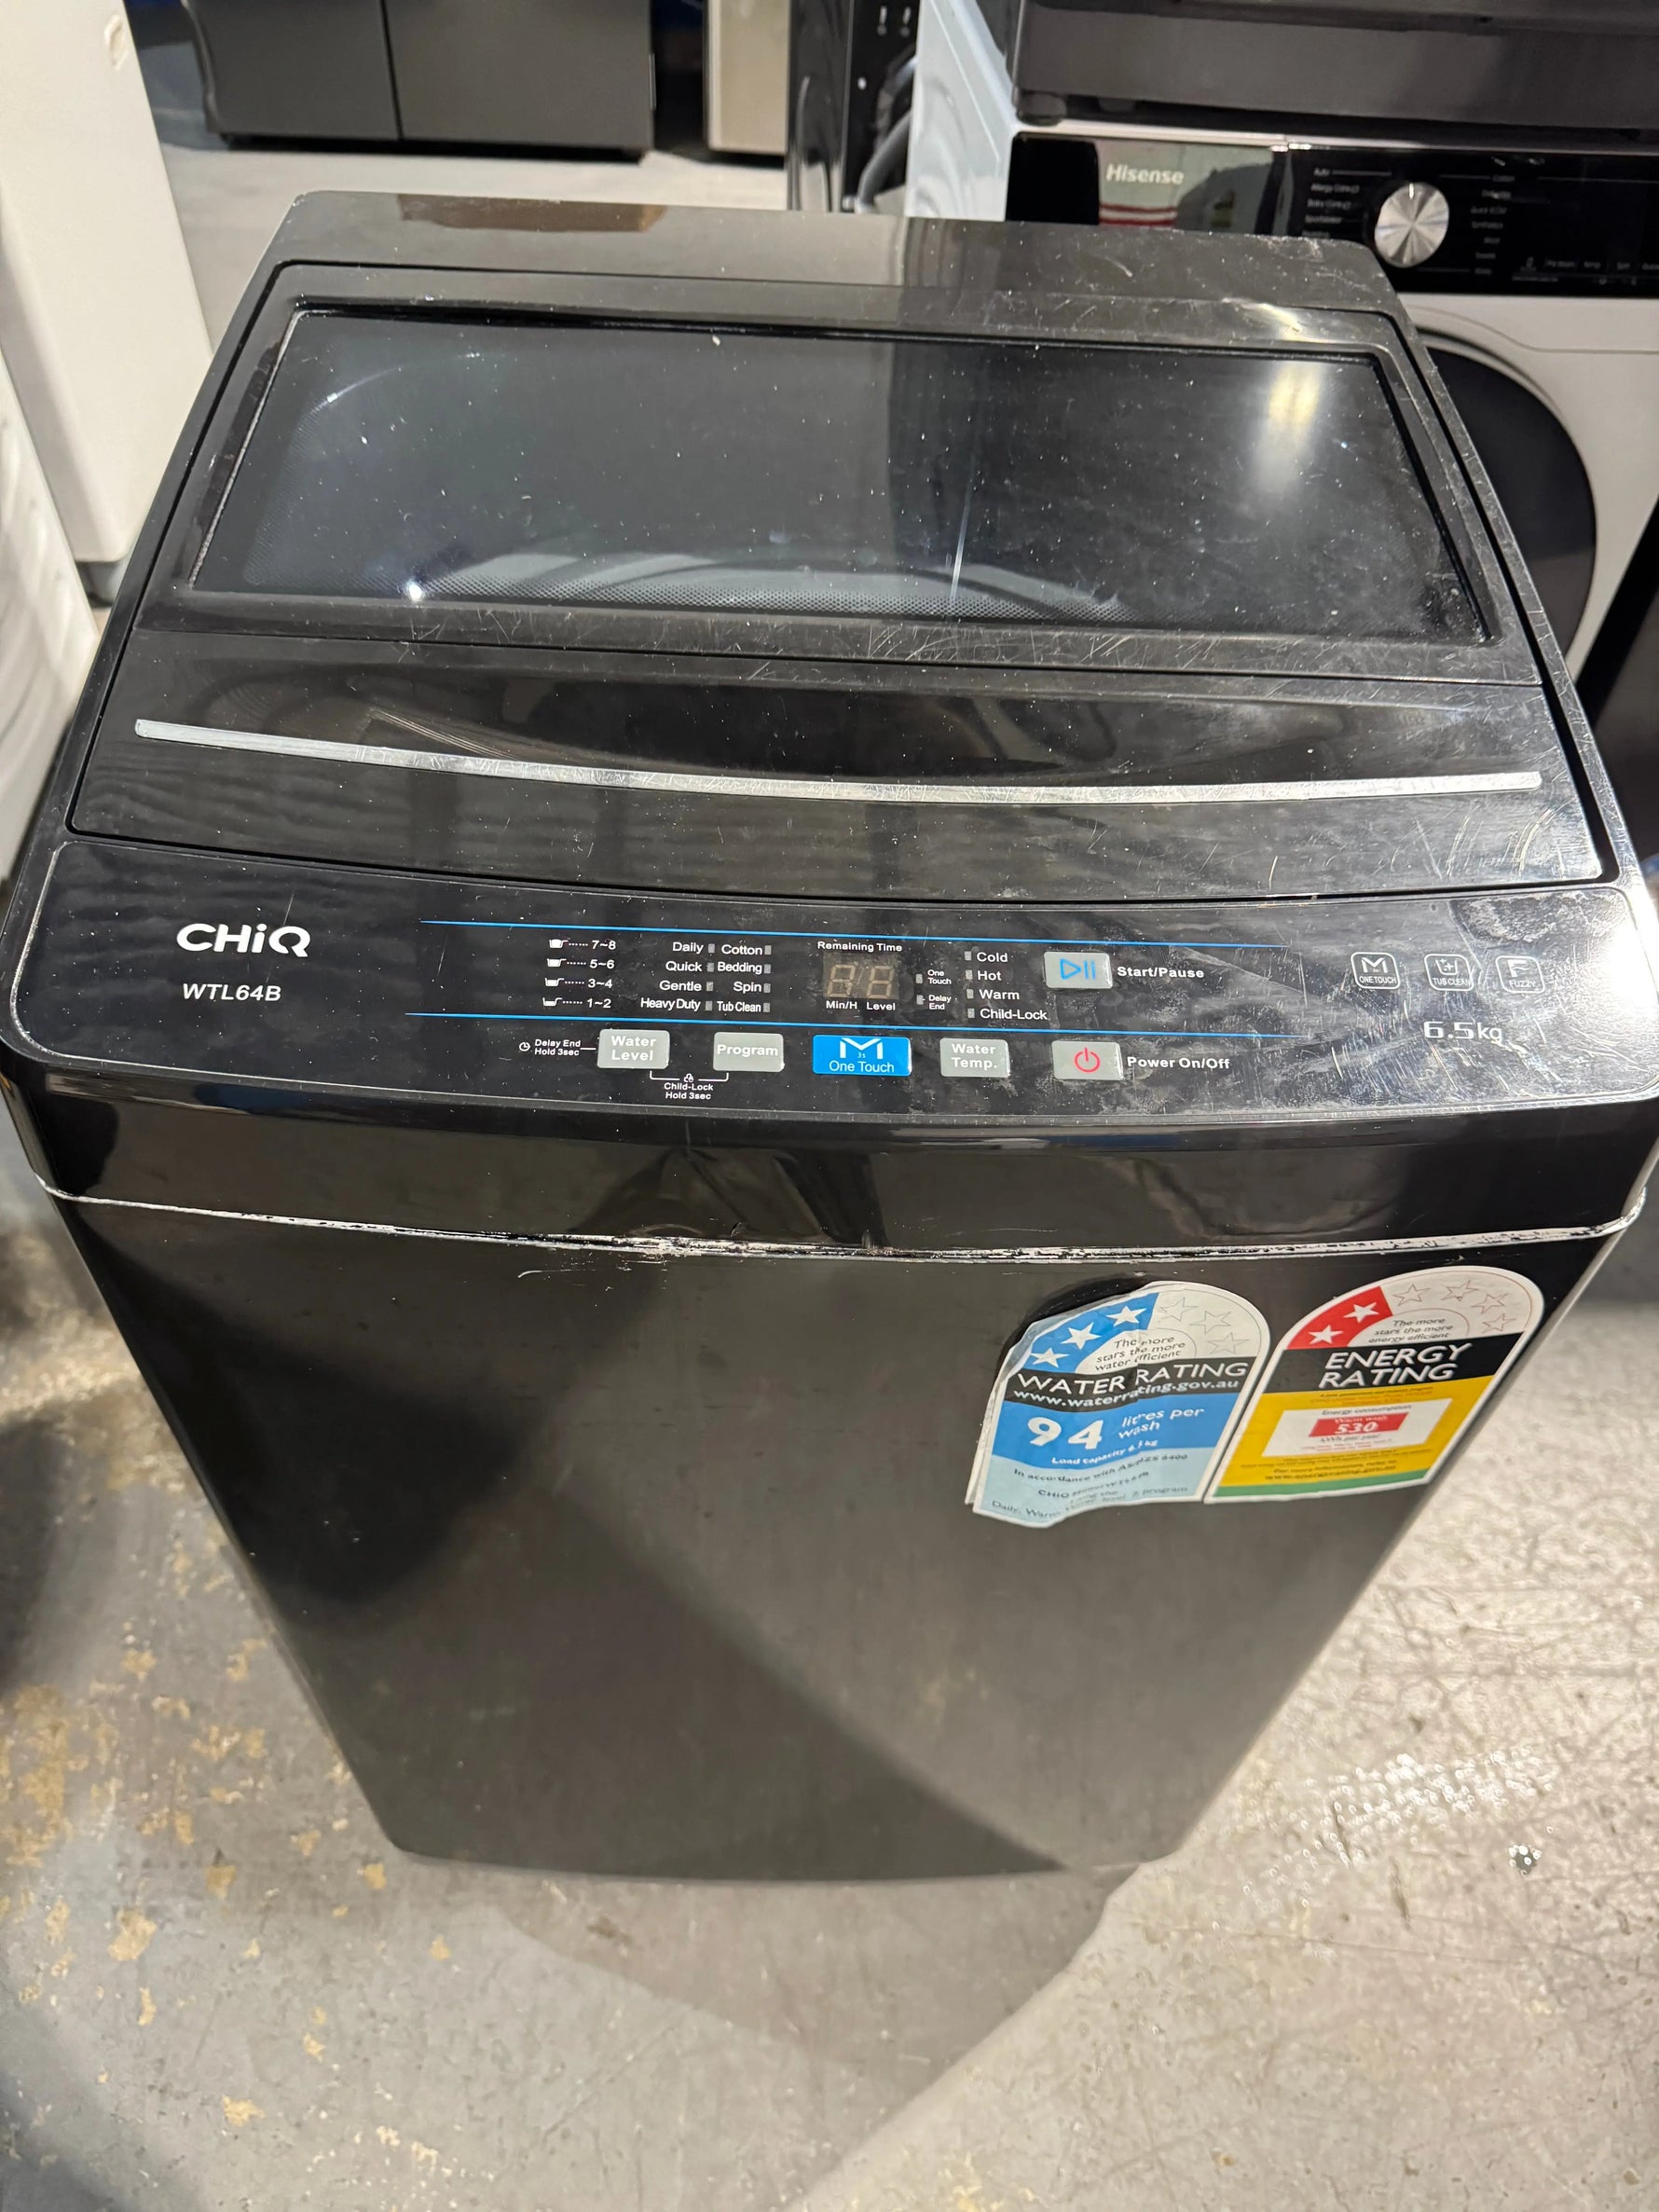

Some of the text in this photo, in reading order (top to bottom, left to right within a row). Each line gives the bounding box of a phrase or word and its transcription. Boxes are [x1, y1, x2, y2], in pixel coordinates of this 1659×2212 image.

[1105, 164, 1184, 185] Hisense
[176, 923, 311, 957] CHiQ
[672, 941, 704, 955] Daily
[721, 944, 763, 956] Cotton
[817, 941, 903, 953] Remaining Time
[977, 952, 1008, 963] Cold
[665, 961, 703, 973] Quick
[717, 962, 762, 975] Bedding
[1117, 966, 1205, 980] Start/Pause
[978, 970, 1003, 982] Hot
[659, 981, 703, 992] Gentle
[733, 981, 762, 996] Spin
[1509, 980, 1536, 988] FUZZY
[183, 982, 281, 1001] WTL64B
[979, 990, 1021, 1001] Warm
[640, 997, 701, 1012] Heavy Duty
[826, 1001, 857, 1010] Min/H
[928, 995, 952, 1003] Delay
[717, 1001, 762, 1013] Tub Clean
[867, 1002, 896, 1010] Level
[980, 1009, 1048, 1022] Child-Lock
[535, 1038, 582, 1050] Delay End
[610, 1035, 656, 1048] Water
[535, 1048, 580, 1057] Hold 3sec
[611, 1050, 654, 1061] Level
[717, 1044, 779, 1058] Program
[952, 1043, 995, 1056] Water
[830, 1061, 895, 1073] One Touch
[952, 1057, 998, 1072] Temp.
[1128, 1056, 1230, 1070] Power On/Off
[664, 1082, 714, 1092] Child-Lock
[665, 1091, 712, 1100] Hold 3sec
[1404, 1326, 1421, 1334] the
[1114, 1339, 1137, 1349] The
[1096, 1350, 1126, 1363] stars
[1152, 1342, 1186, 1353] more
[1324, 1342, 1473, 1370] ENERGY
[1095, 1359, 1131, 1372] water
[1017, 1363, 1249, 1396] WATER RATING
[1319, 1363, 1459, 1389] RATING
[1014, 1380, 1240, 1408] www.waterrating.gov.au
[1122, 1408, 1204, 1428] litres per
[1027, 1417, 1104, 1449] 94
[1118, 1421, 1160, 1439] wash
[1335, 1422, 1379, 1435] 530
[1051, 1456, 1081, 1465] Load
[1083, 1449, 1126, 1465] capacity
[1014, 1468, 1025, 1477] In
[1093, 1467, 1117, 1479] with
